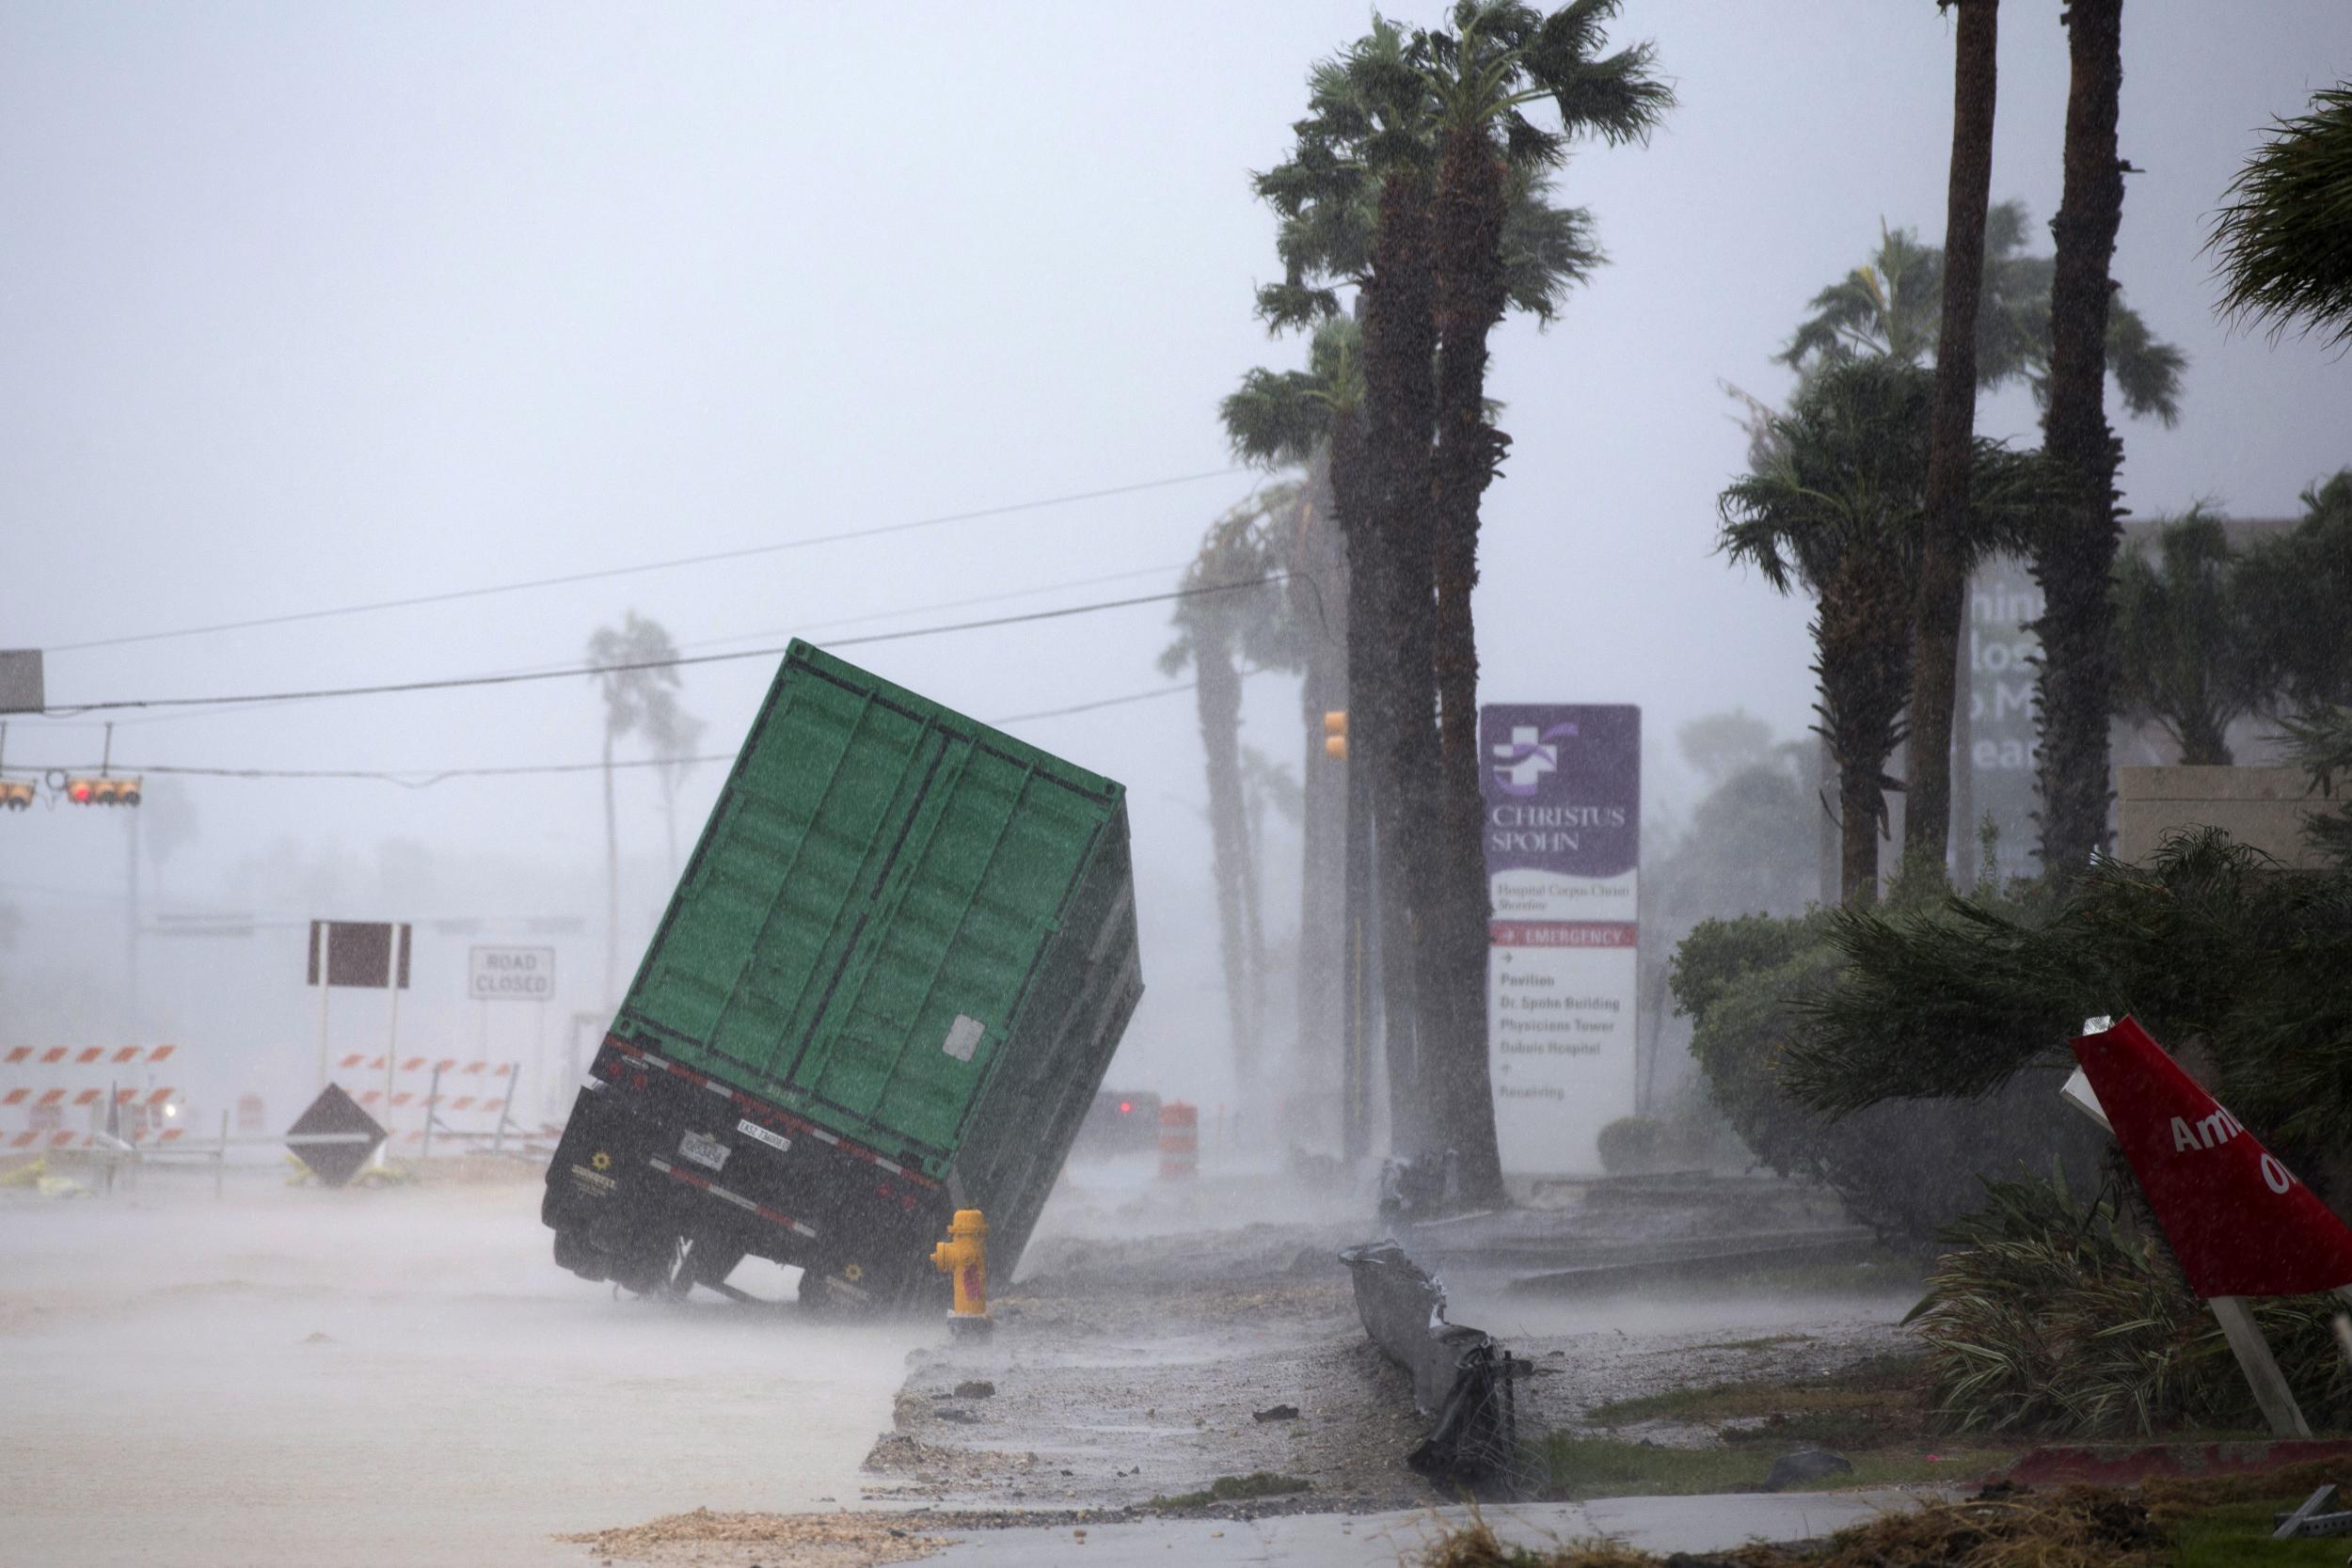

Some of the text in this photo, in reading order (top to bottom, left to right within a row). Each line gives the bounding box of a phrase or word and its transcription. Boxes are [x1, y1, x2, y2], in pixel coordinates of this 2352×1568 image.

[1492, 805, 1626, 827] CHRISTUS
[1492, 832, 1579, 851] SPOHN
[1499, 884, 1629, 899] Hospital Corpus Christi
[1525, 928, 1623, 943] EMERGENCY
[485, 953, 536, 970] ROAD
[475, 974, 548, 992] CLOSED
[1501, 973, 1555, 987] Pavilion
[1522, 997, 1562, 1014] Spohn
[1565, 997, 1620, 1014] Building
[1501, 1019, 1614, 1034] Physicians Tower
[1549, 1041, 1600, 1057] Hospital
[1501, 1085, 1565, 1101] Receiving
[2170, 1108, 2241, 1152] Am
